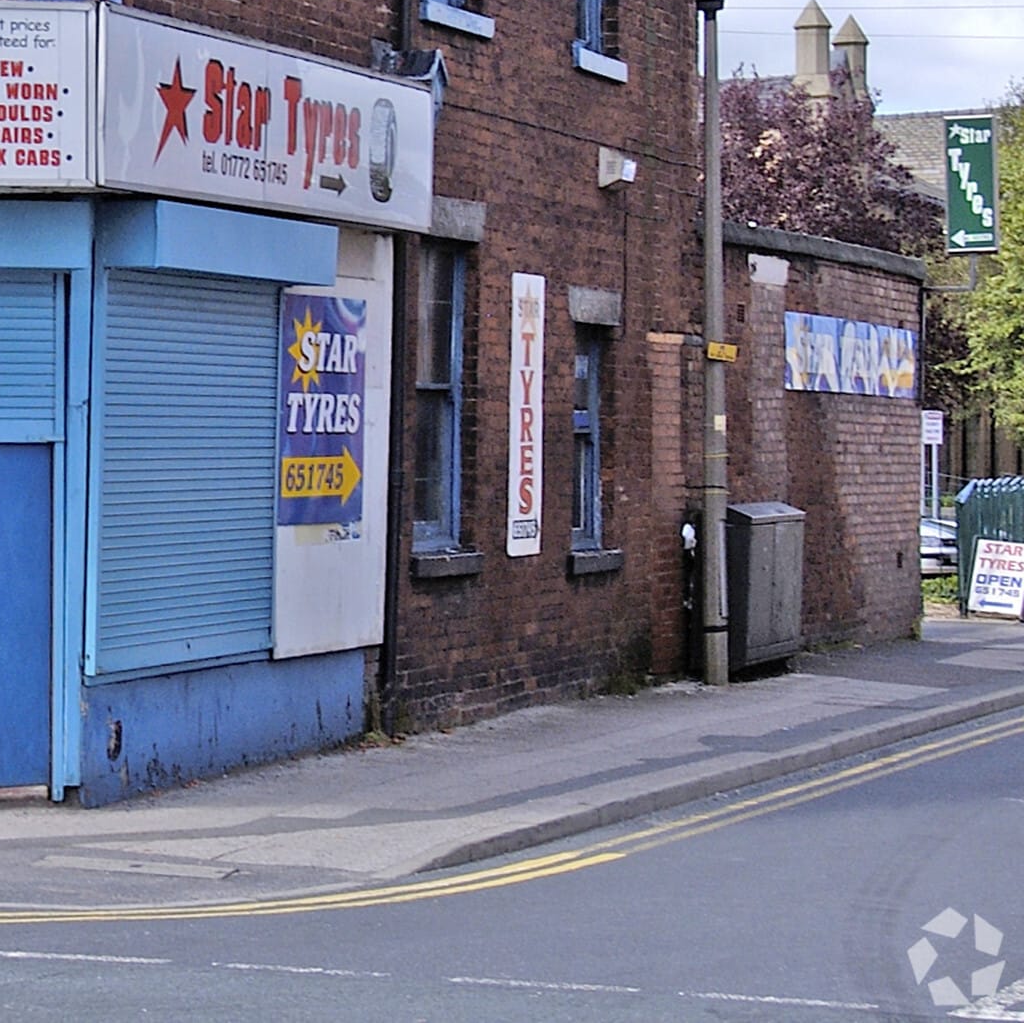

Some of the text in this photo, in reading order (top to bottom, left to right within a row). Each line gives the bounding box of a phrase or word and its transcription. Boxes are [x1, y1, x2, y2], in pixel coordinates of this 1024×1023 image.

[10, 18, 51, 34] prices
[6, 83, 58, 100] WORN
[202, 58, 362, 190] Star Tyres
[959, 127, 991, 144] Star
[15, 149, 61, 166] CABS
[202, 150, 288, 186] tel. 01772 651745
[947, 147, 993, 227] Tyres
[297, 330, 358, 374] STAR
[286, 392, 362, 434] TYRES
[518, 333, 534, 515] TYRES
[286, 463, 344, 492] 651745
[983, 543, 1023, 557] STAR
[979, 557, 1024, 572] TYRES
[976, 573, 1023, 588] OPEN
